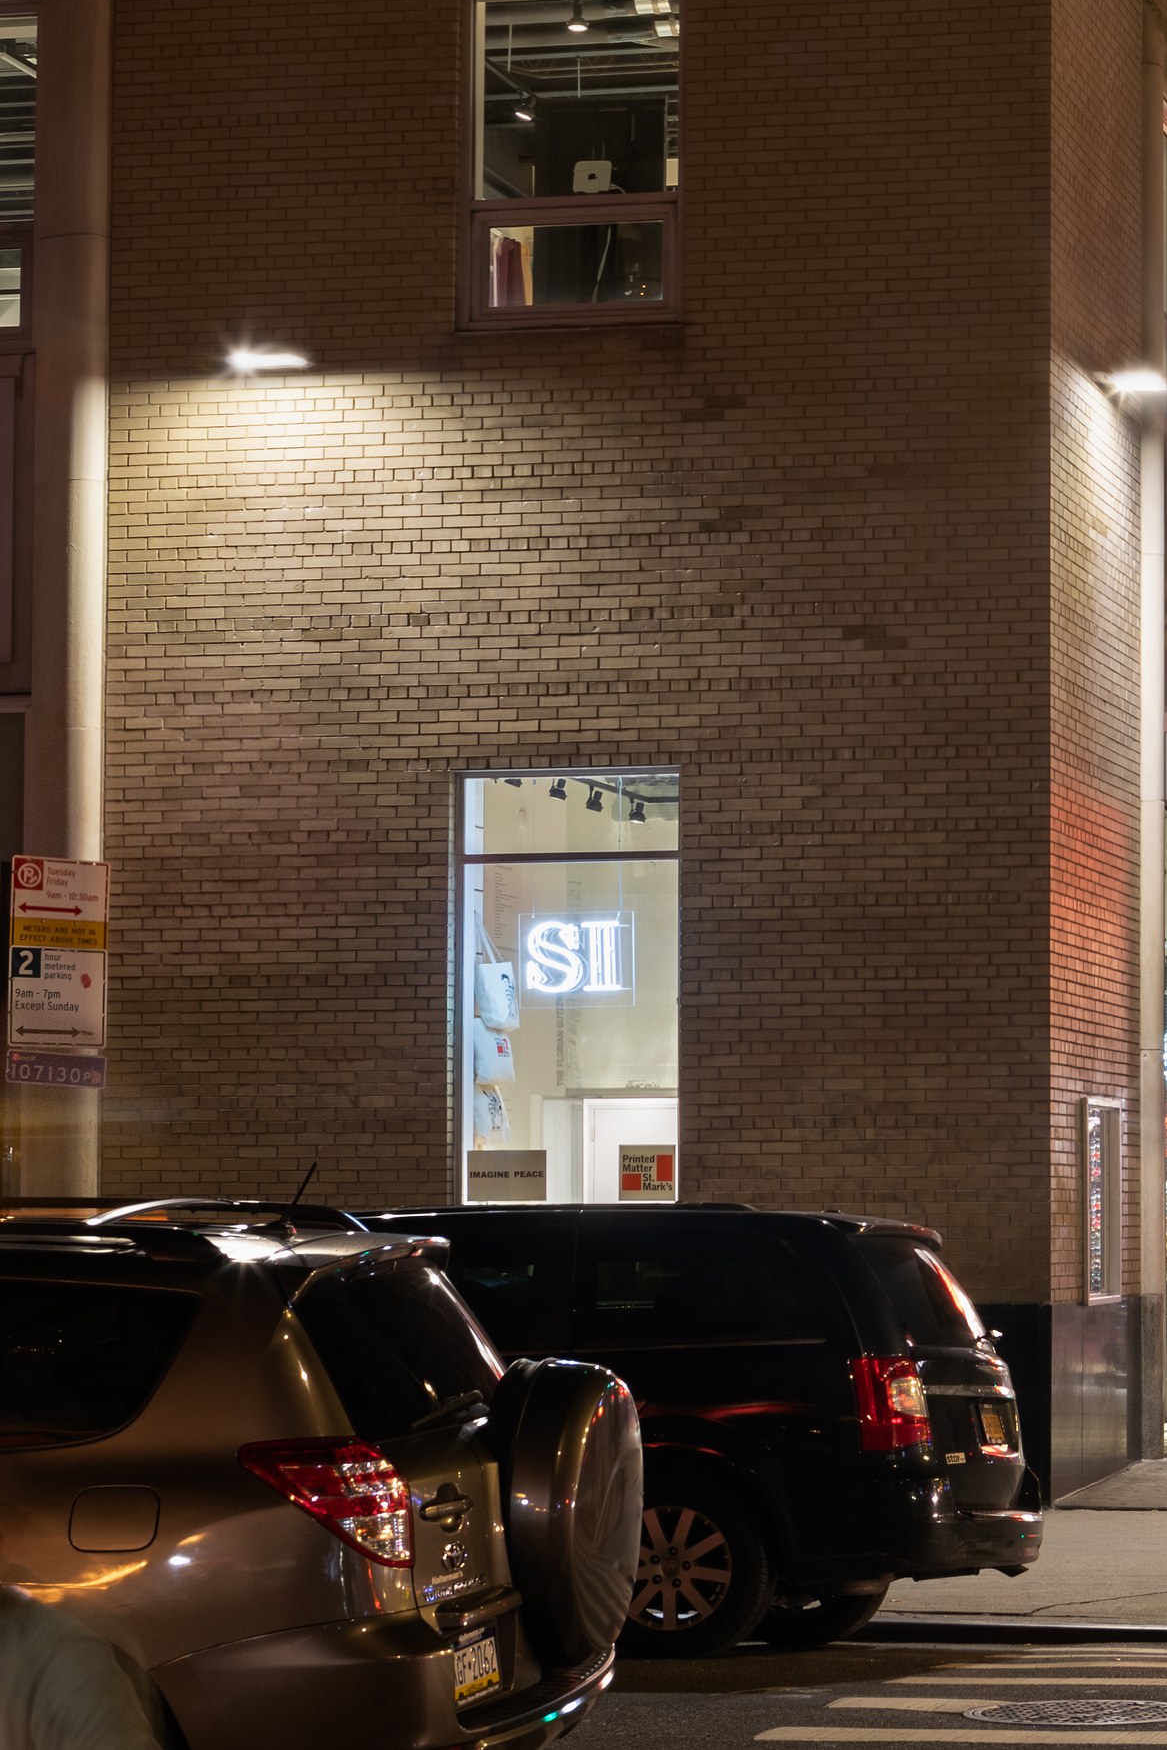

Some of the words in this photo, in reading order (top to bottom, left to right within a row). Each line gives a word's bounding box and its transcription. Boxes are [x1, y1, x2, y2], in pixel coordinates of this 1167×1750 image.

[48, 867, 75, 878] Tuesday
[47, 877, 69, 887] Friday
[46, 891, 62, 899] 9am
[23, 925, 51, 933] METERS
[20, 934, 46, 942] EFFECT
[50, 935, 73, 944] ABOVE
[77, 938, 98, 946] TIMES
[45, 953, 61, 961] hour
[526, 919, 622, 994] SI
[18, 950, 34, 975] 2
[44, 963, 76, 971] metered
[44, 972, 72, 981] parking
[15, 988, 34, 998] 9am
[43, 989, 61, 1000] 7pm
[15, 1001, 45, 1012] Except
[48, 1002, 80, 1013] Sunday
[622, 1154, 656, 1164] Printed
[622, 1163, 653, 1173] Matter
[469, 1171, 510, 1179] IMAGINE
[513, 1170, 545, 1179] PEACE
[642, 1173, 656, 1182] St.
[642, 1182, 674, 1192] Mark's
